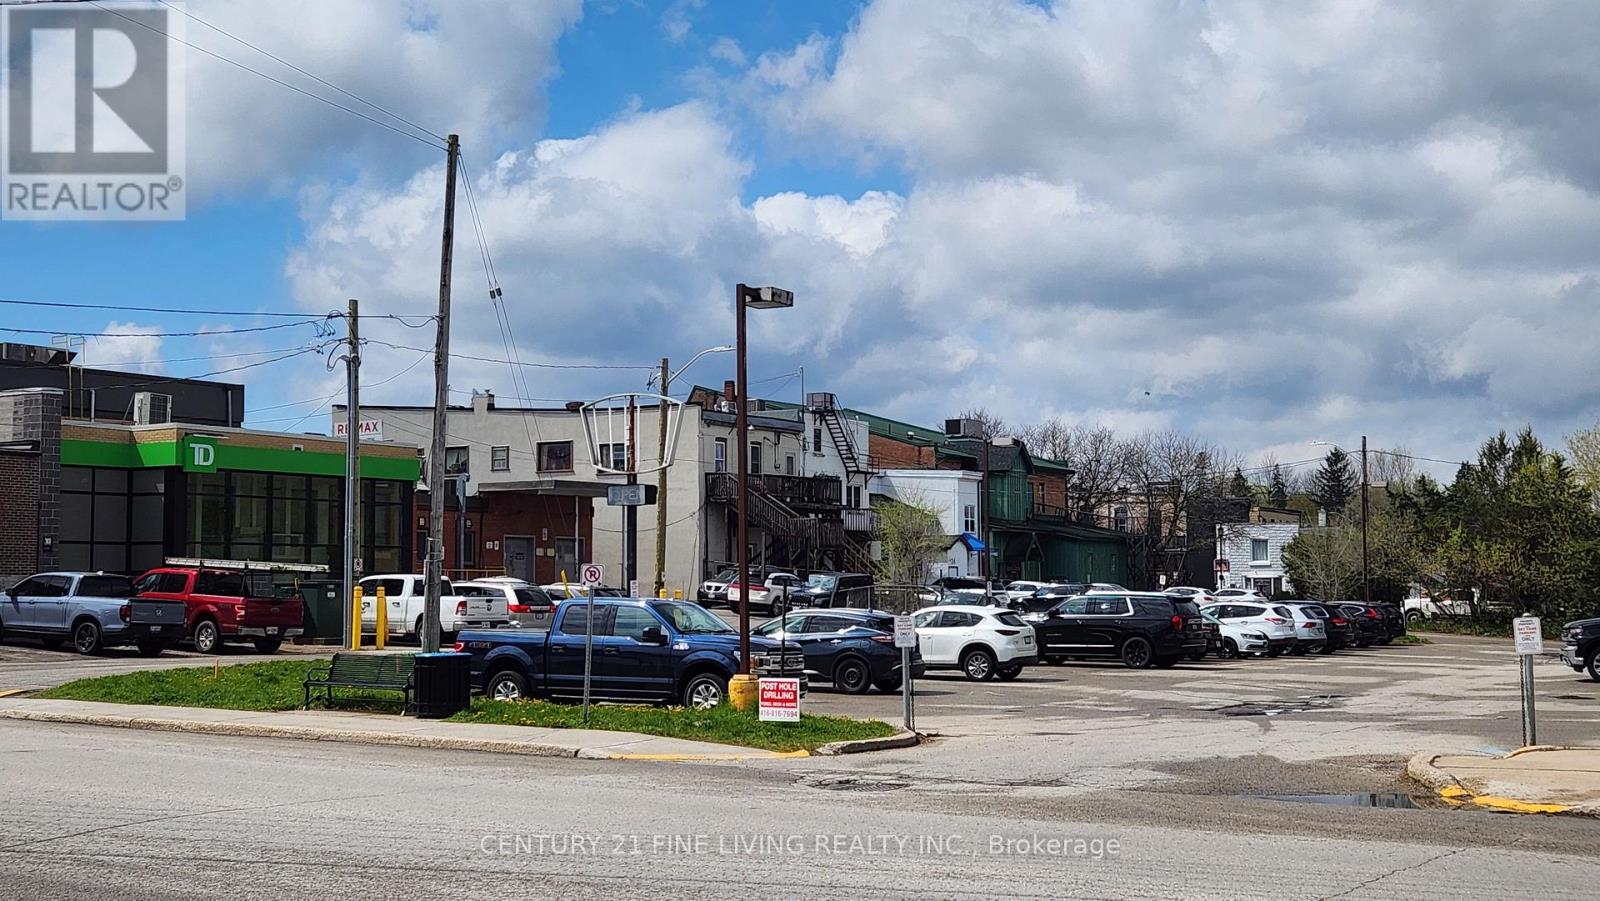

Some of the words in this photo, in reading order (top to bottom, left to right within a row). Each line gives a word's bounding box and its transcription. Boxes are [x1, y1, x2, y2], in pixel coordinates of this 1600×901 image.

[190, 443, 214, 465] TD
[761, 682, 777, 690] POST
[779, 682, 797, 690] HOLE
[763, 691, 794, 699] DRILLING
